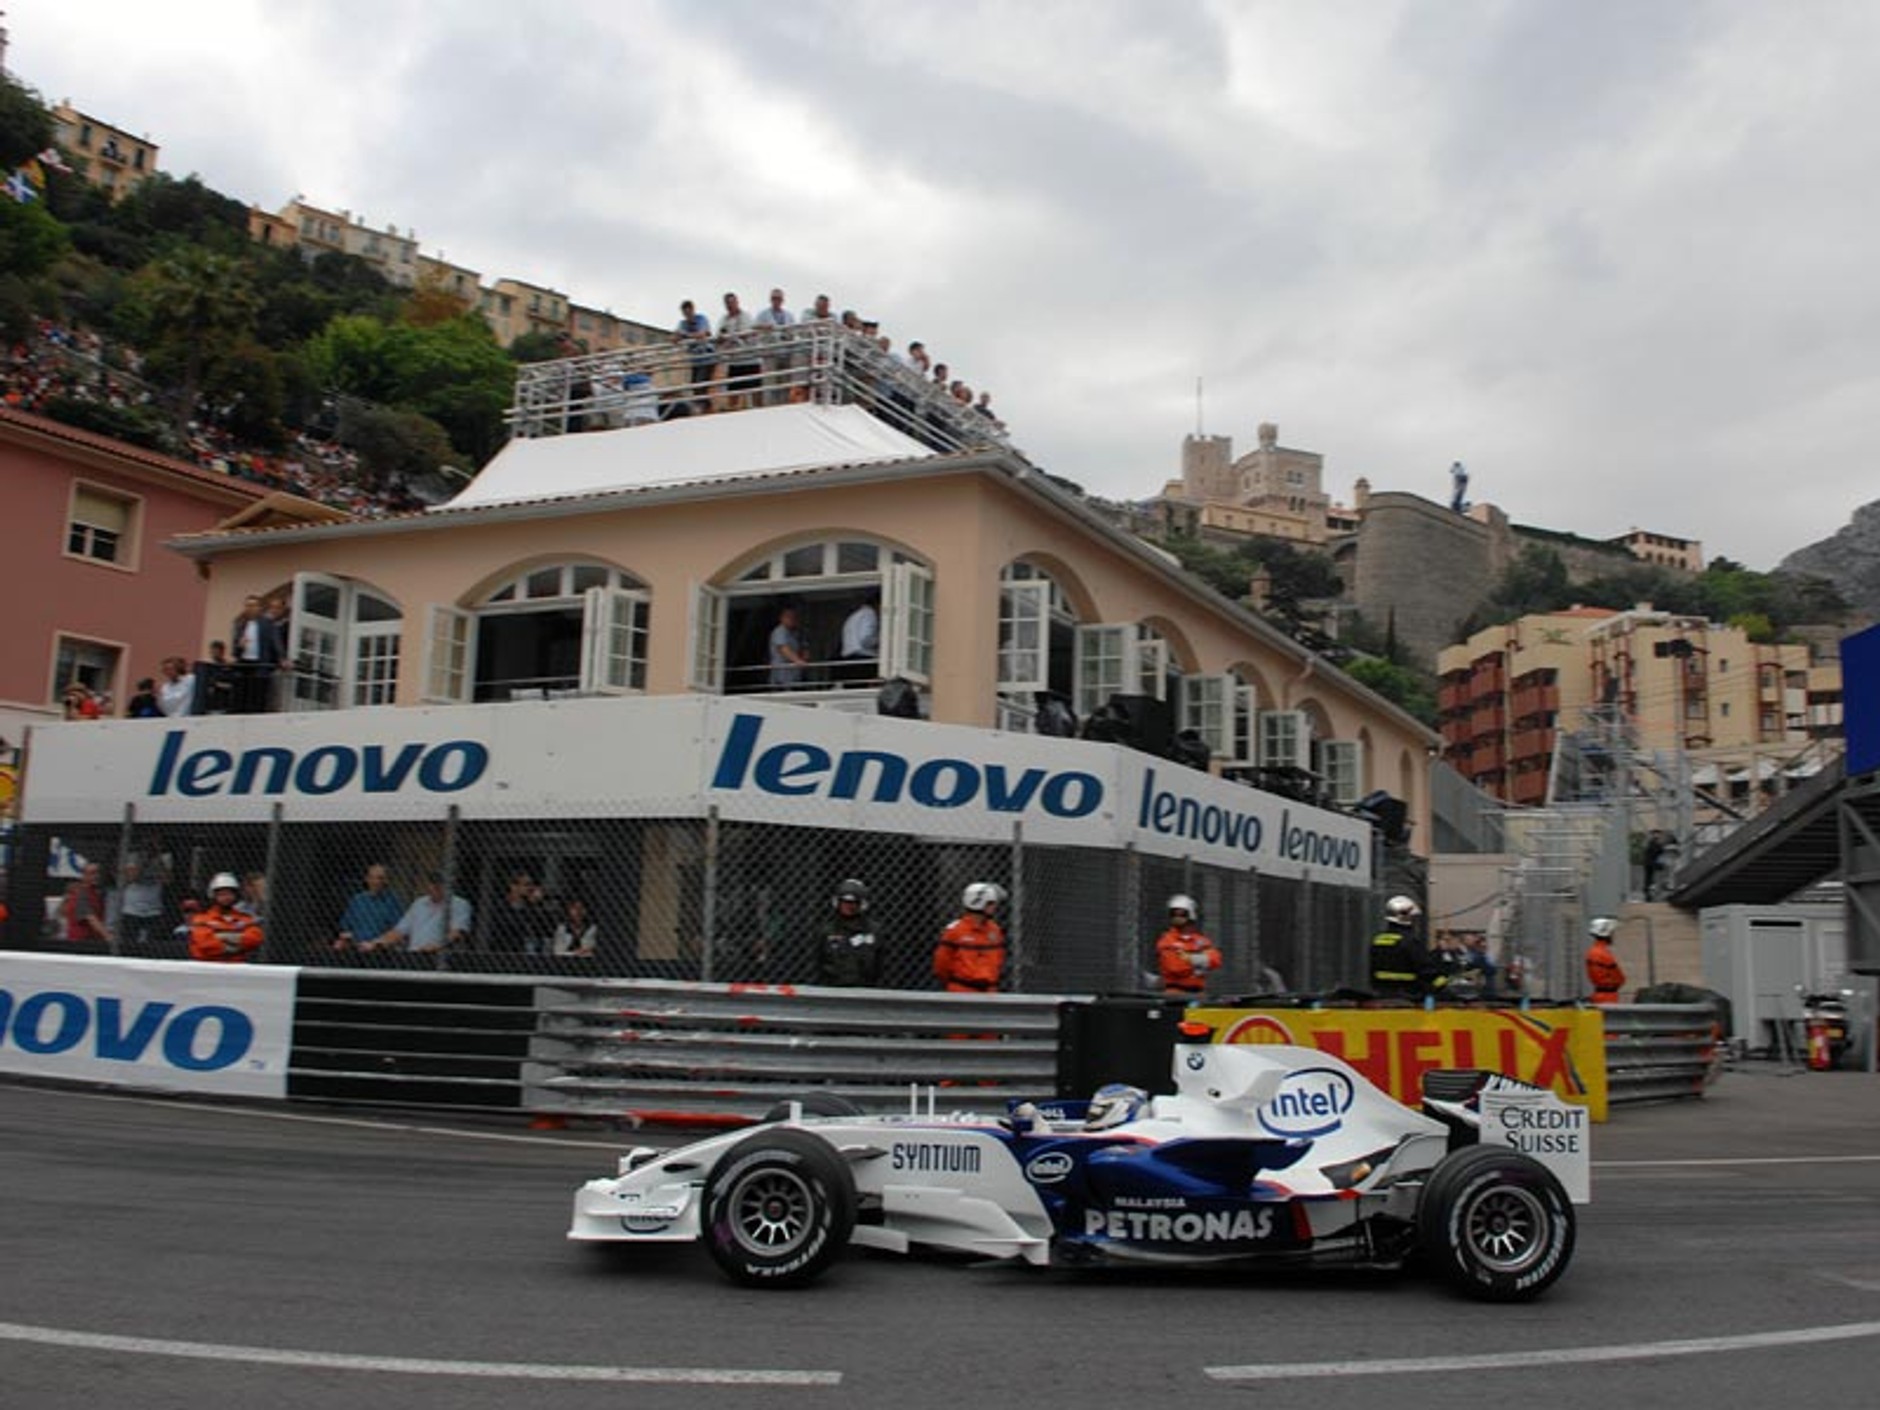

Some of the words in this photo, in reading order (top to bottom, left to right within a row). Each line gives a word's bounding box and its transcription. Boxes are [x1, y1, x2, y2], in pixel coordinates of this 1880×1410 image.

[147, 730, 489, 797] lenovo
[711, 714, 1103, 819] lenovo
[1139, 767, 1262, 853] lenovo
[1278, 808, 1360, 871] lenovo
[0, 988, 254, 1072] ovo
[1271, 1082, 1338, 1117] intel
[1501, 1106, 1584, 1129] CREDIT
[893, 1142, 981, 1173] SYNTIUM
[1505, 1130, 1580, 1153] SUISSE
[1084, 1208, 1274, 1242] PETRONAS
